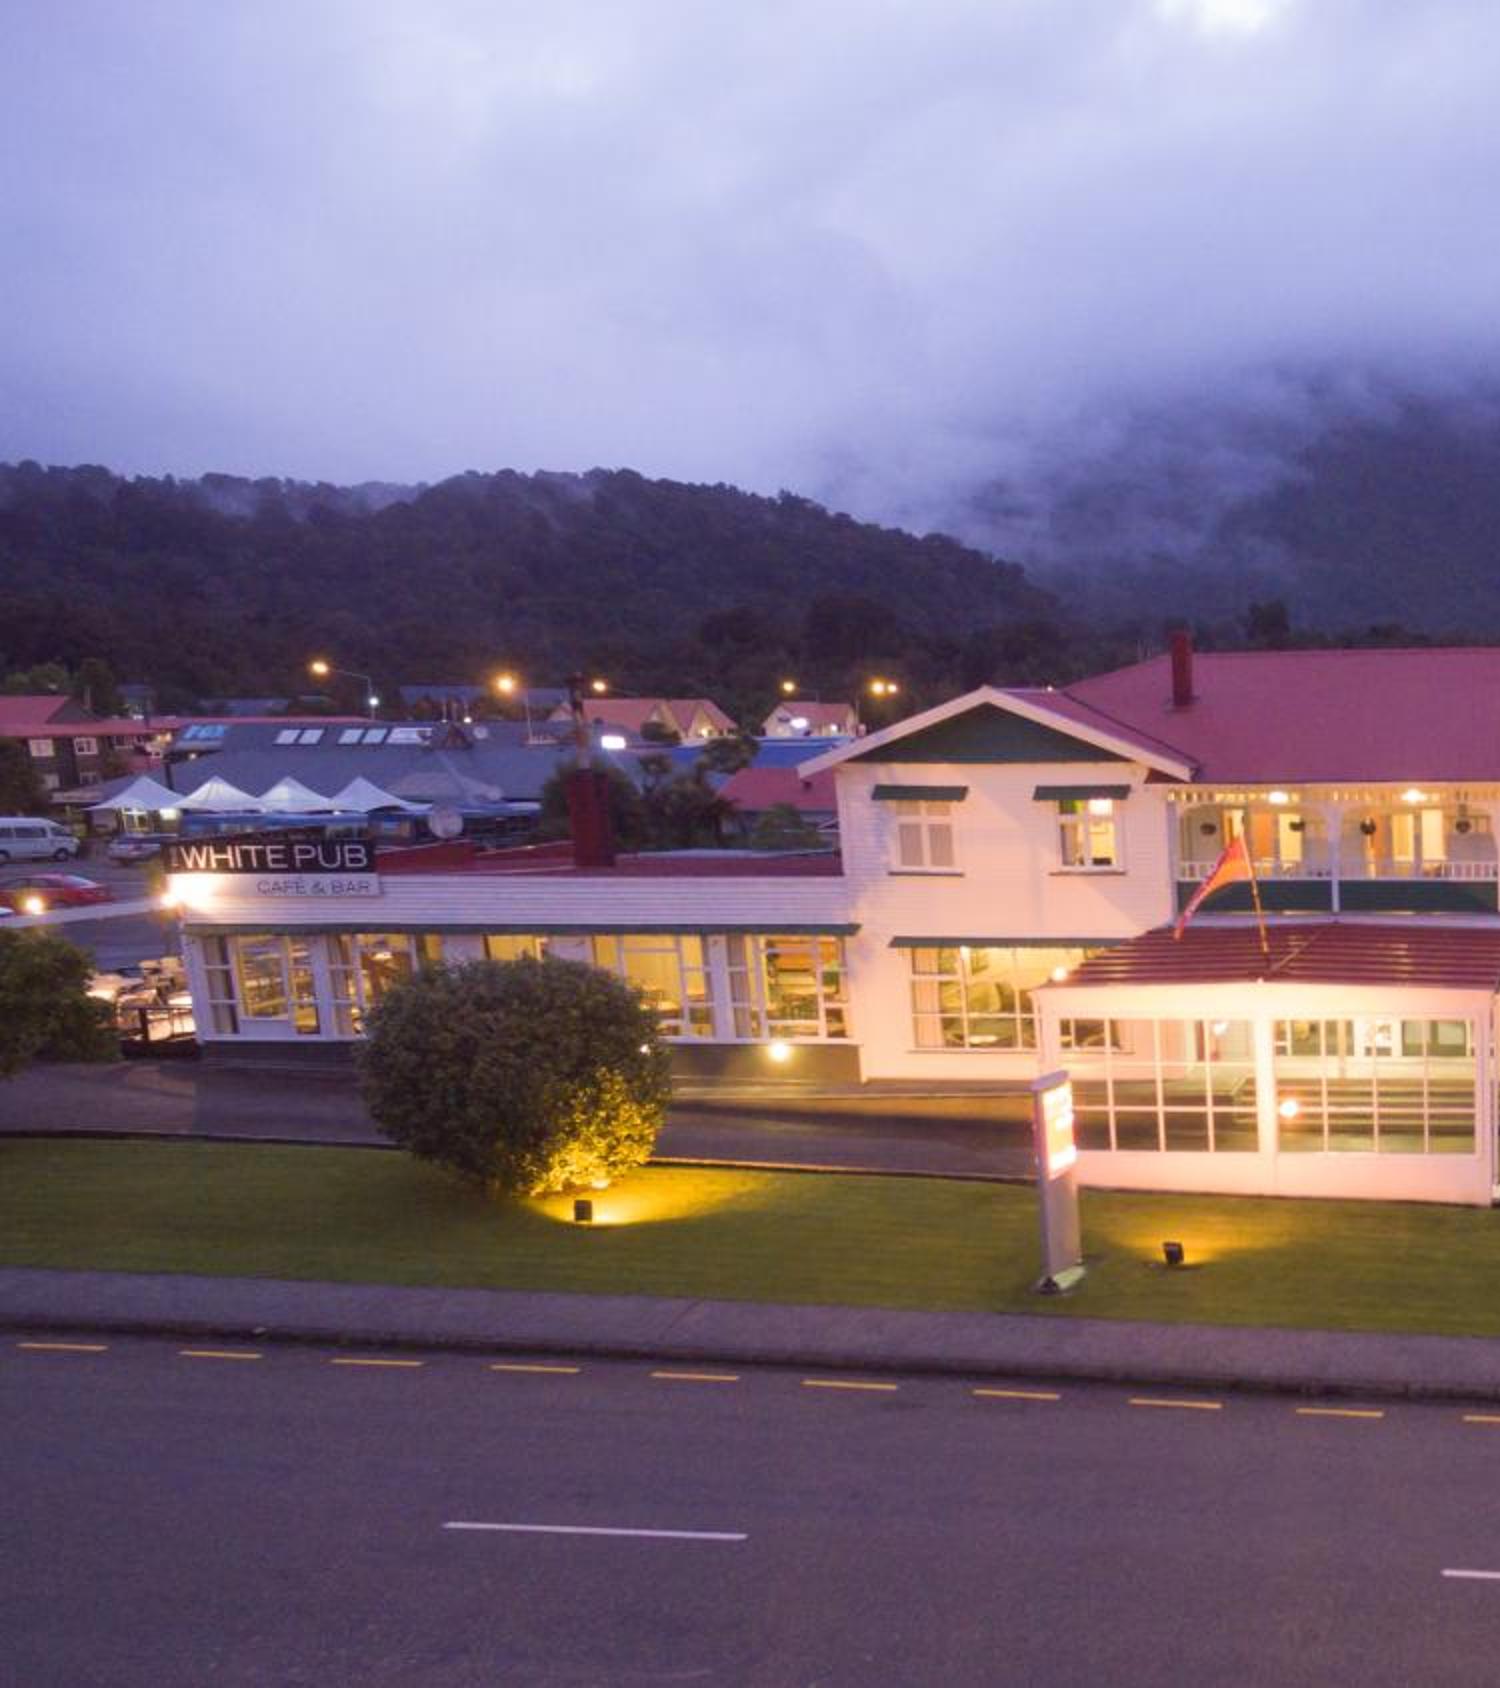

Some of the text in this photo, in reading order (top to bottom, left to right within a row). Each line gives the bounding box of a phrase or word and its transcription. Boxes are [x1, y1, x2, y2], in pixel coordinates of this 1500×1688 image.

[180, 845, 288, 868] WHITE
[294, 845, 368, 868] PUB
[311, 880, 326, 894] &
[332, 880, 369, 894] BAR
